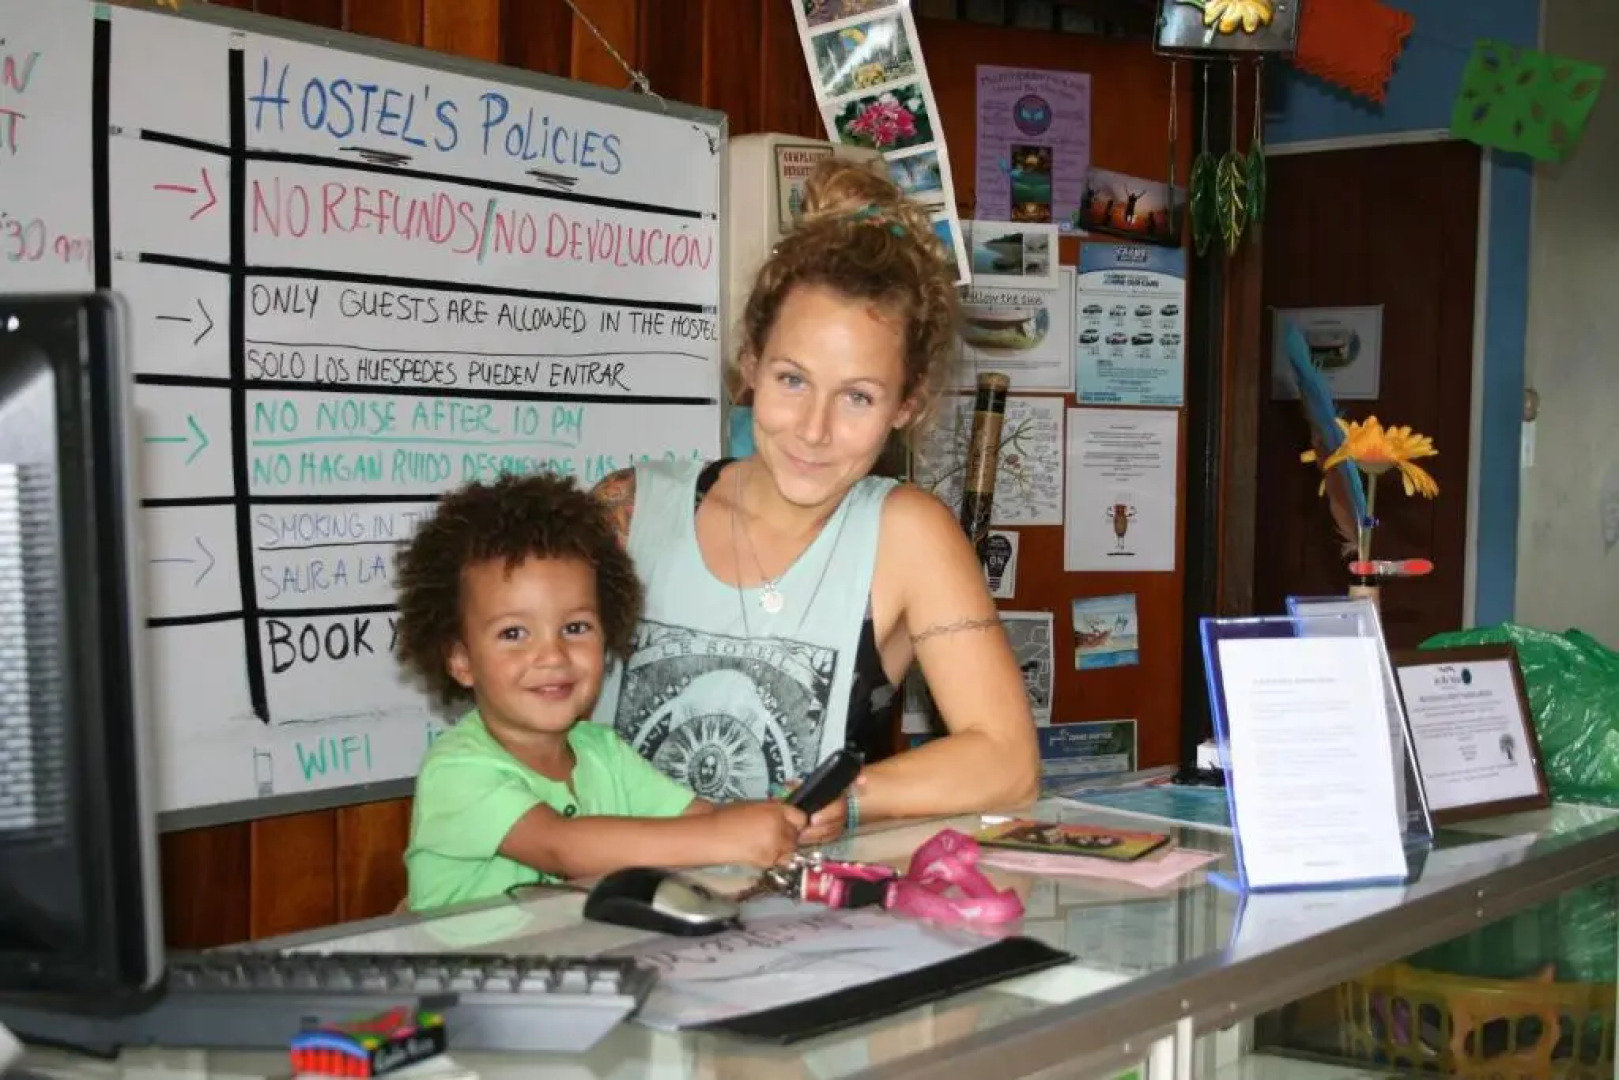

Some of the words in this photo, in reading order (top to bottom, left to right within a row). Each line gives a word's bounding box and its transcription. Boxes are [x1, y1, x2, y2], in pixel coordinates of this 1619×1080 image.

[249, 57, 458, 152] HOSTEL'S
[253, 177, 309, 238] NO
[252, 283, 318, 319] ONLY
[339, 289, 439, 323] GUESTS
[447, 297, 489, 324] ARE
[498, 303, 587, 333] ALLOWED
[600, 304, 621, 333] IN
[628, 311, 665, 336] THE
[671, 314, 718, 342] HOSTEL
[248, 349, 305, 380] SOLO
[315, 353, 350, 384] LOS
[357, 356, 458, 385] HUESPEDES
[468, 359, 540, 386] PUEDEN
[549, 361, 631, 392] ENTRAR
[254, 400, 299, 434] NO
[316, 399, 396, 434] NOISE
[412, 400, 500, 434] AFTER
[514, 406, 539, 436] 10
[551, 404, 584, 443] PM
[252, 453, 292, 485] NO
[300, 451, 382, 484] HAGAN
[391, 449, 451, 485] RUIDO
[256, 511, 365, 546] SMOKING
[374, 513, 393, 537] IN
[333, 558, 349, 586] A
[358, 554, 387, 584] LA
[265, 616, 374, 674] BOOK
[295, 732, 372, 780] WIFI
